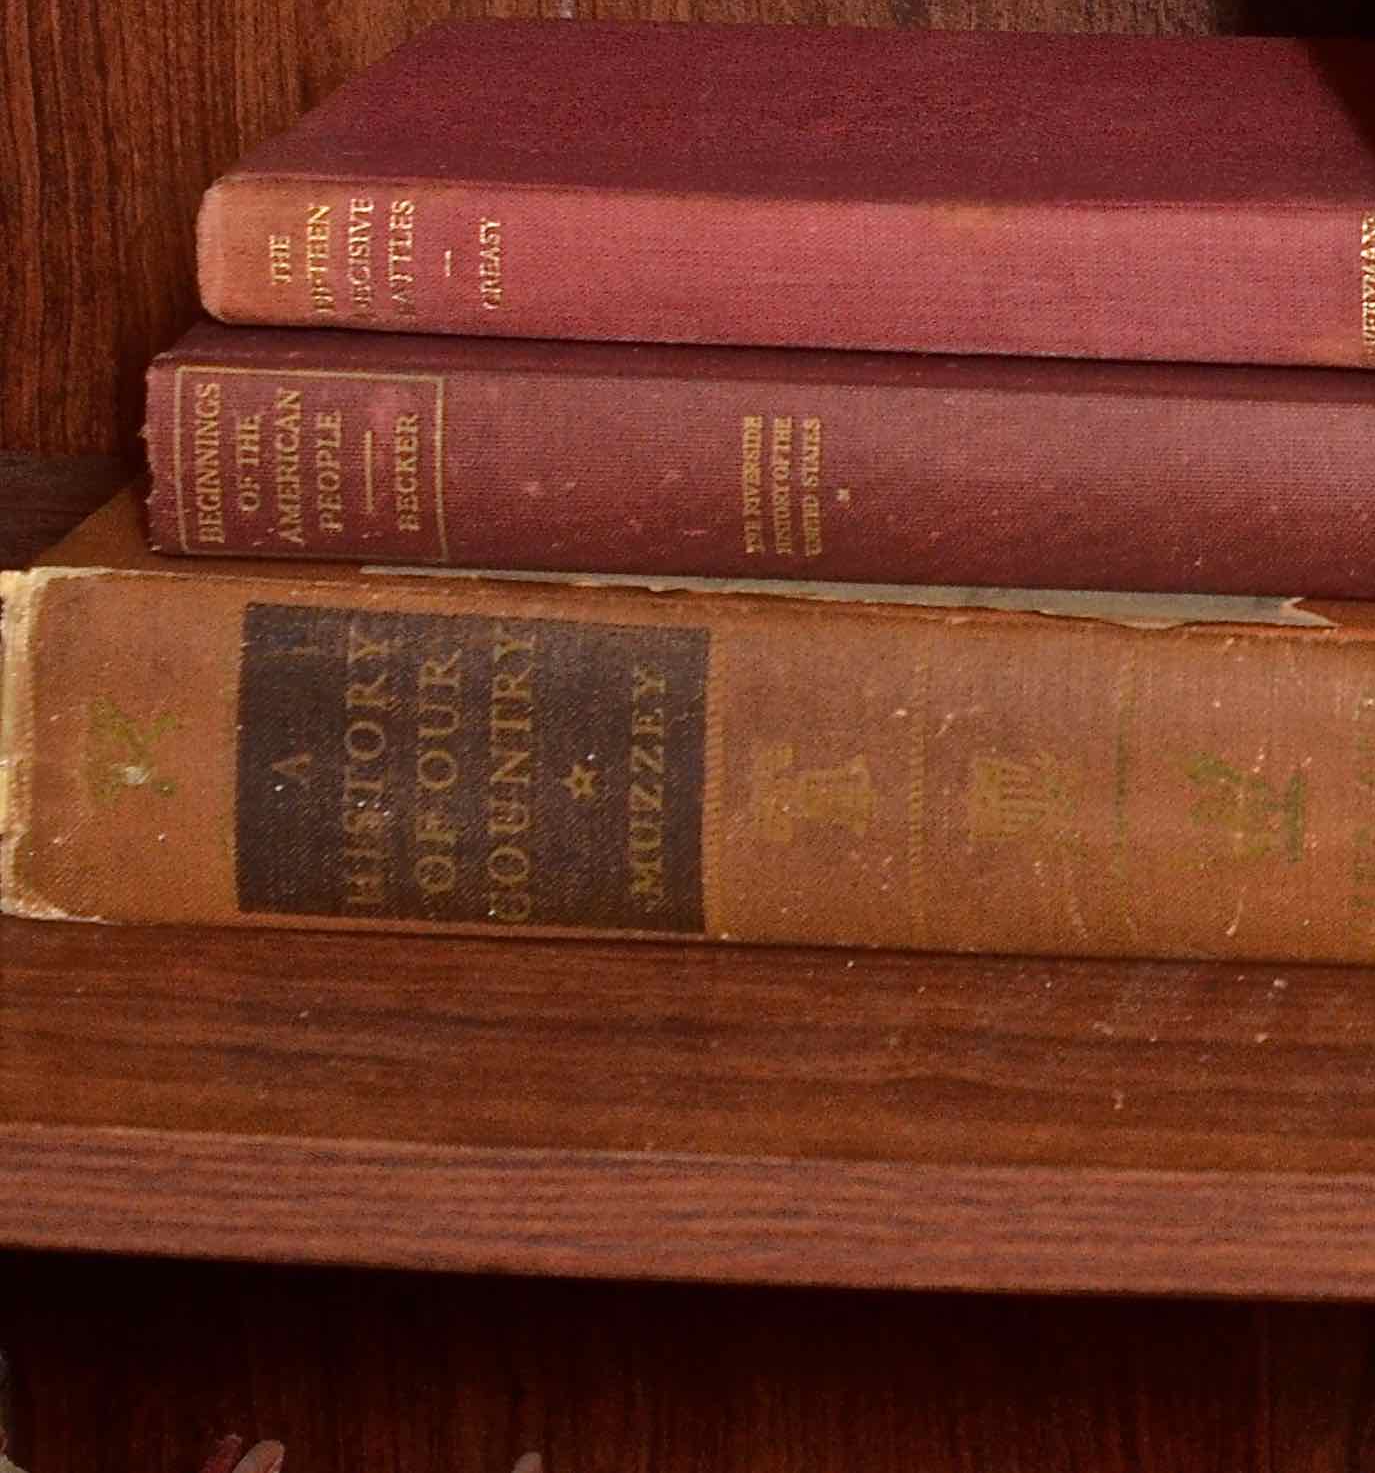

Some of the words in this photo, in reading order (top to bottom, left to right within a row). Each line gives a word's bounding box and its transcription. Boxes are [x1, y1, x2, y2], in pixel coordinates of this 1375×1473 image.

[268, 234, 293, 285] THE
[346, 197, 375, 317] ECISIVE
[478, 217, 504, 311] CREASY
[195, 382, 226, 544] BEGINNINGS
[238, 414, 264, 467] THE
[273, 387, 305, 544] AMERICAN
[314, 411, 344, 533] PEOPLE
[395, 412, 420, 532] BECKER
[742, 415, 764, 517] RIVERSIDE
[771, 457, 792, 480] OF
[772, 415, 793, 456] THE
[801, 415, 822, 488] STATES
[238, 475, 261, 512] OF
[773, 483, 794, 555] HISTORY
[344, 627, 390, 906] HISTORY
[416, 648, 462, 791] OUR
[487, 631, 536, 921] COUNTRY
[628, 662, 668, 901] MUZZEY
[413, 811, 460, 895] OF
